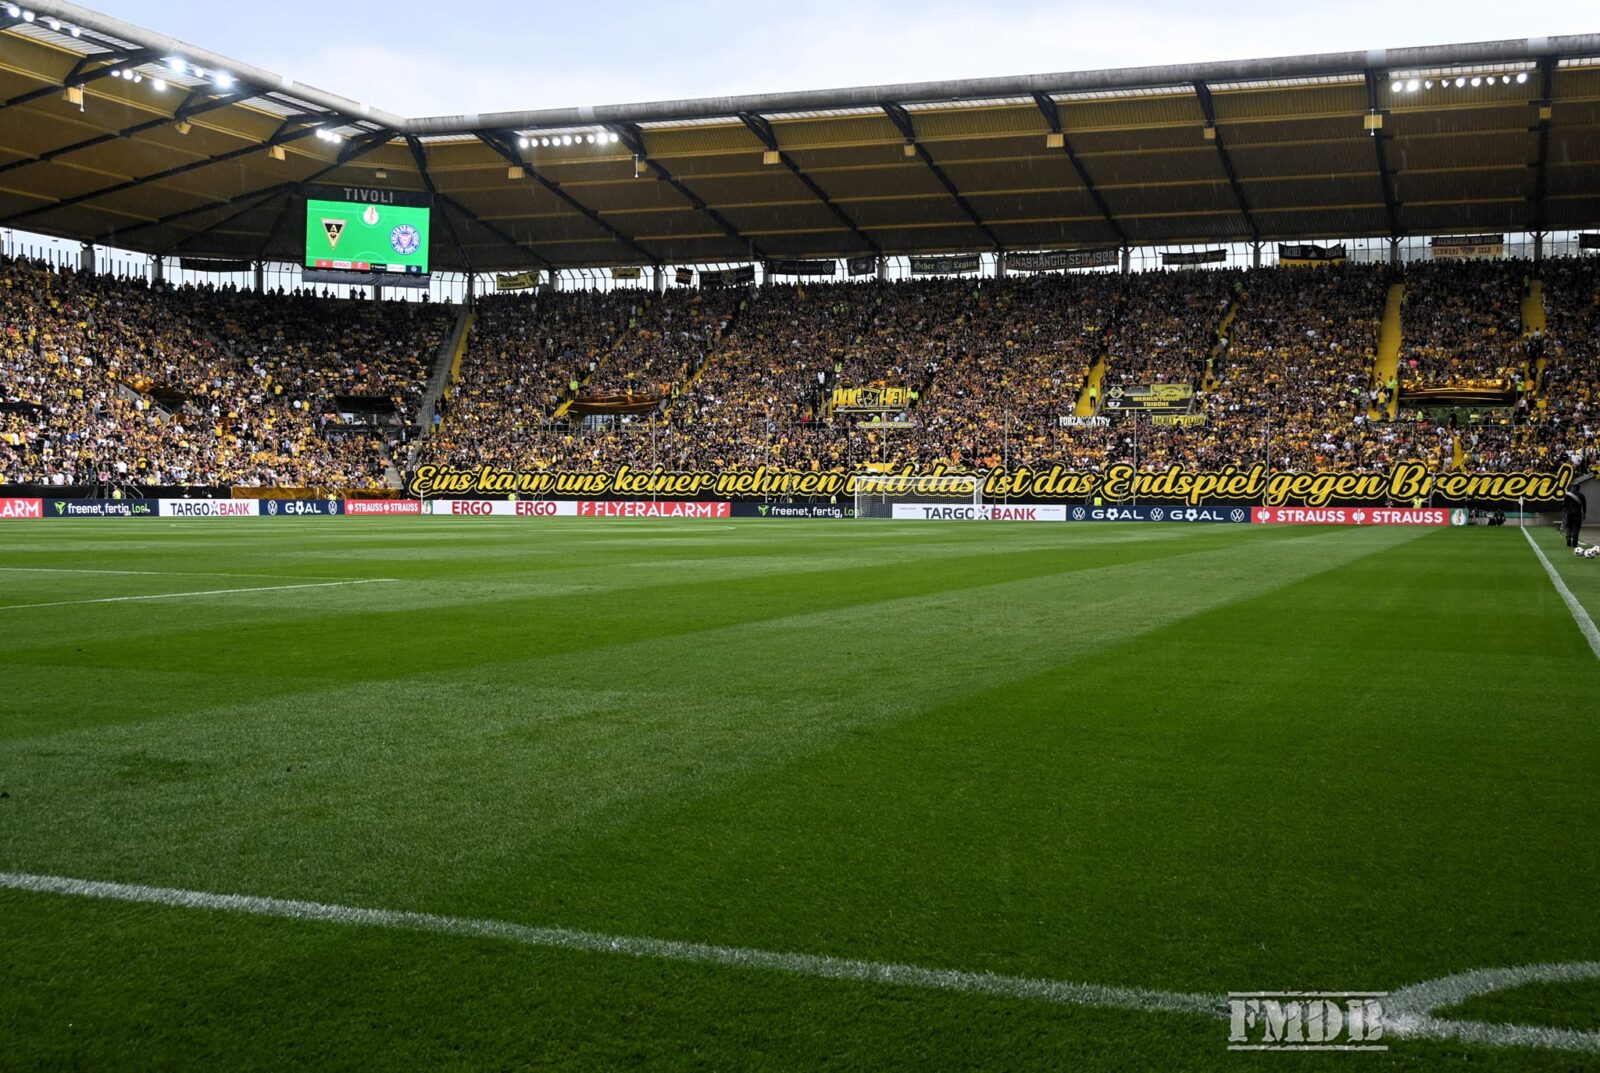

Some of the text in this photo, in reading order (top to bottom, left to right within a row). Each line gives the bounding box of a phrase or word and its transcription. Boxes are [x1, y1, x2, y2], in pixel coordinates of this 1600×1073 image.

[344, 188, 393, 203] TIVOLI
[1068, 252, 1091, 265] SEIT
[1093, 250, 1115, 263] 1900
[412, 463, 1570, 506] Eins kann uns keiner nehmen und das ist das Endspiel gegen Bremen!
[354, 502, 383, 513] STRAUSS
[390, 503, 418, 513] STRAUSS
[451, 501, 493, 515] ERGO
[515, 501, 557, 515] ERGO
[594, 502, 711, 517] FLYERALARM
[1276, 510, 1346, 523] STRAUSS
[1371, 511, 1443, 524] STRAUSS
